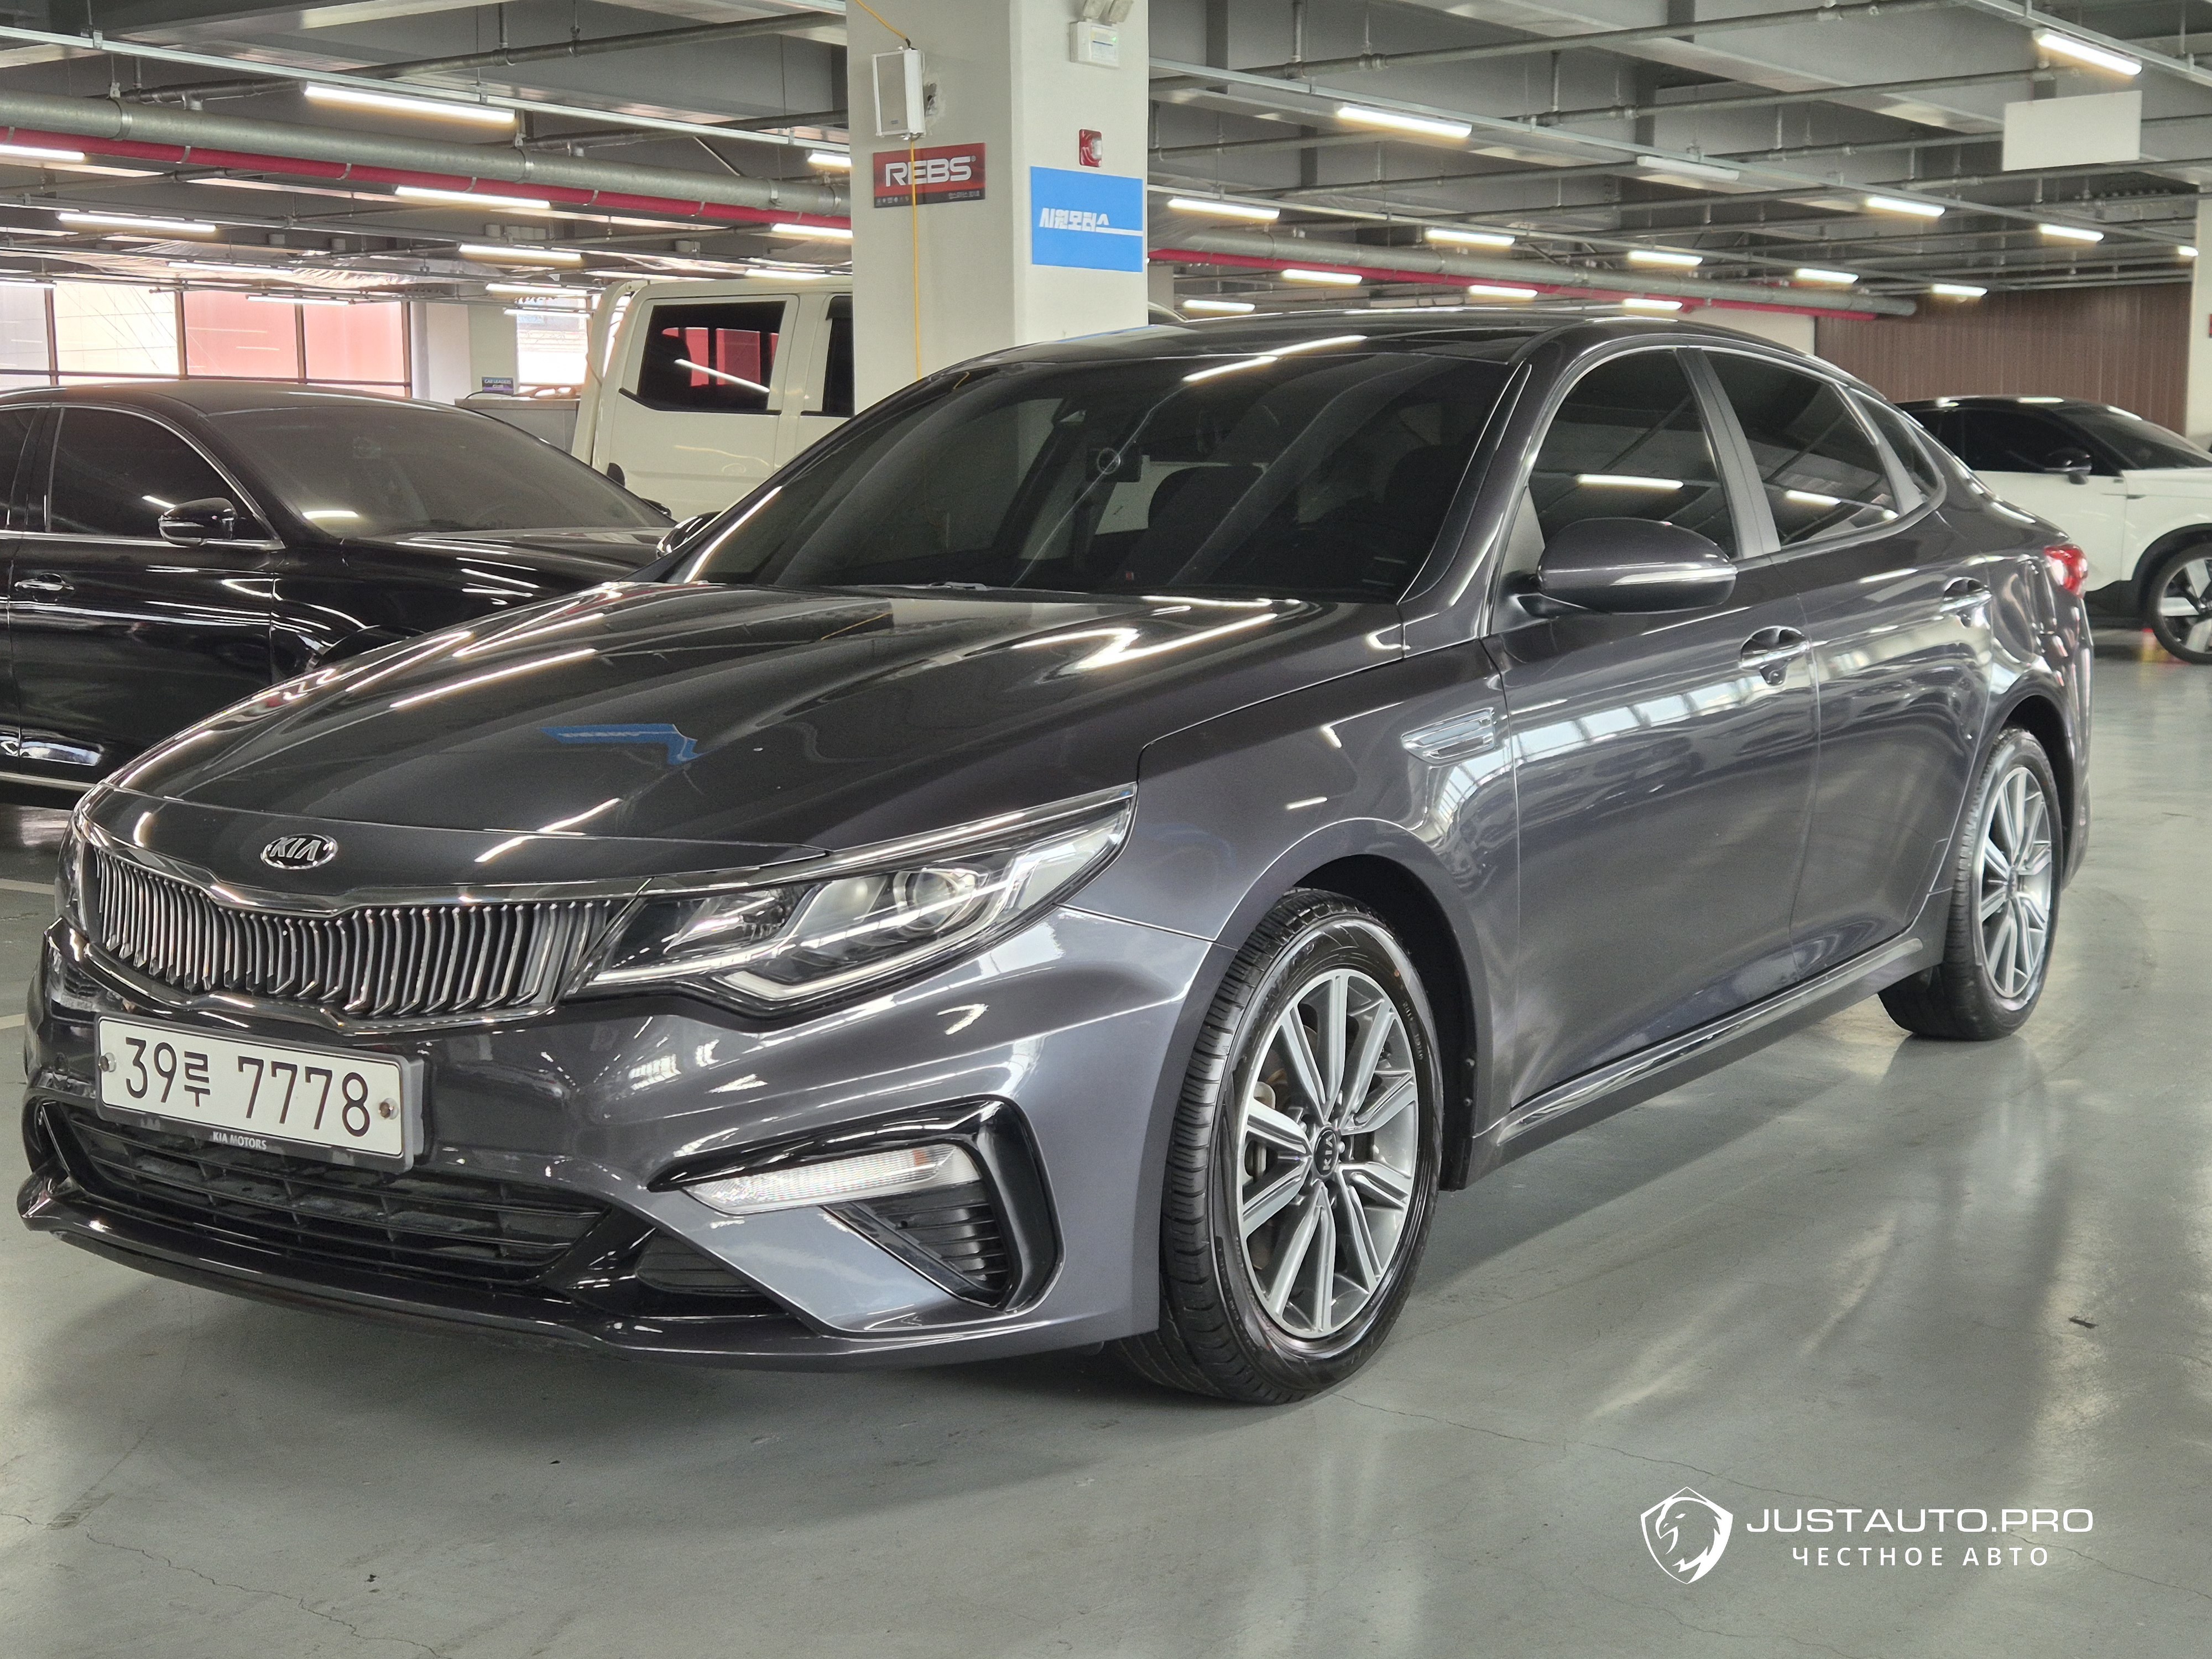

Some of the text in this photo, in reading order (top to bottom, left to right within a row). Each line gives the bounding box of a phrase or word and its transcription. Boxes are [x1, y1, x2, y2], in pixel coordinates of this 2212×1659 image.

[886, 156, 972, 187] REBS
[1039, 207, 1143, 237] 시원모터스
[269, 837, 322, 861] KIA
[125, 1036, 371, 1137] 39루 7778
[213, 1131, 267, 1150] KIA MOTORS
[1322, 1133, 1333, 1171] KIA
